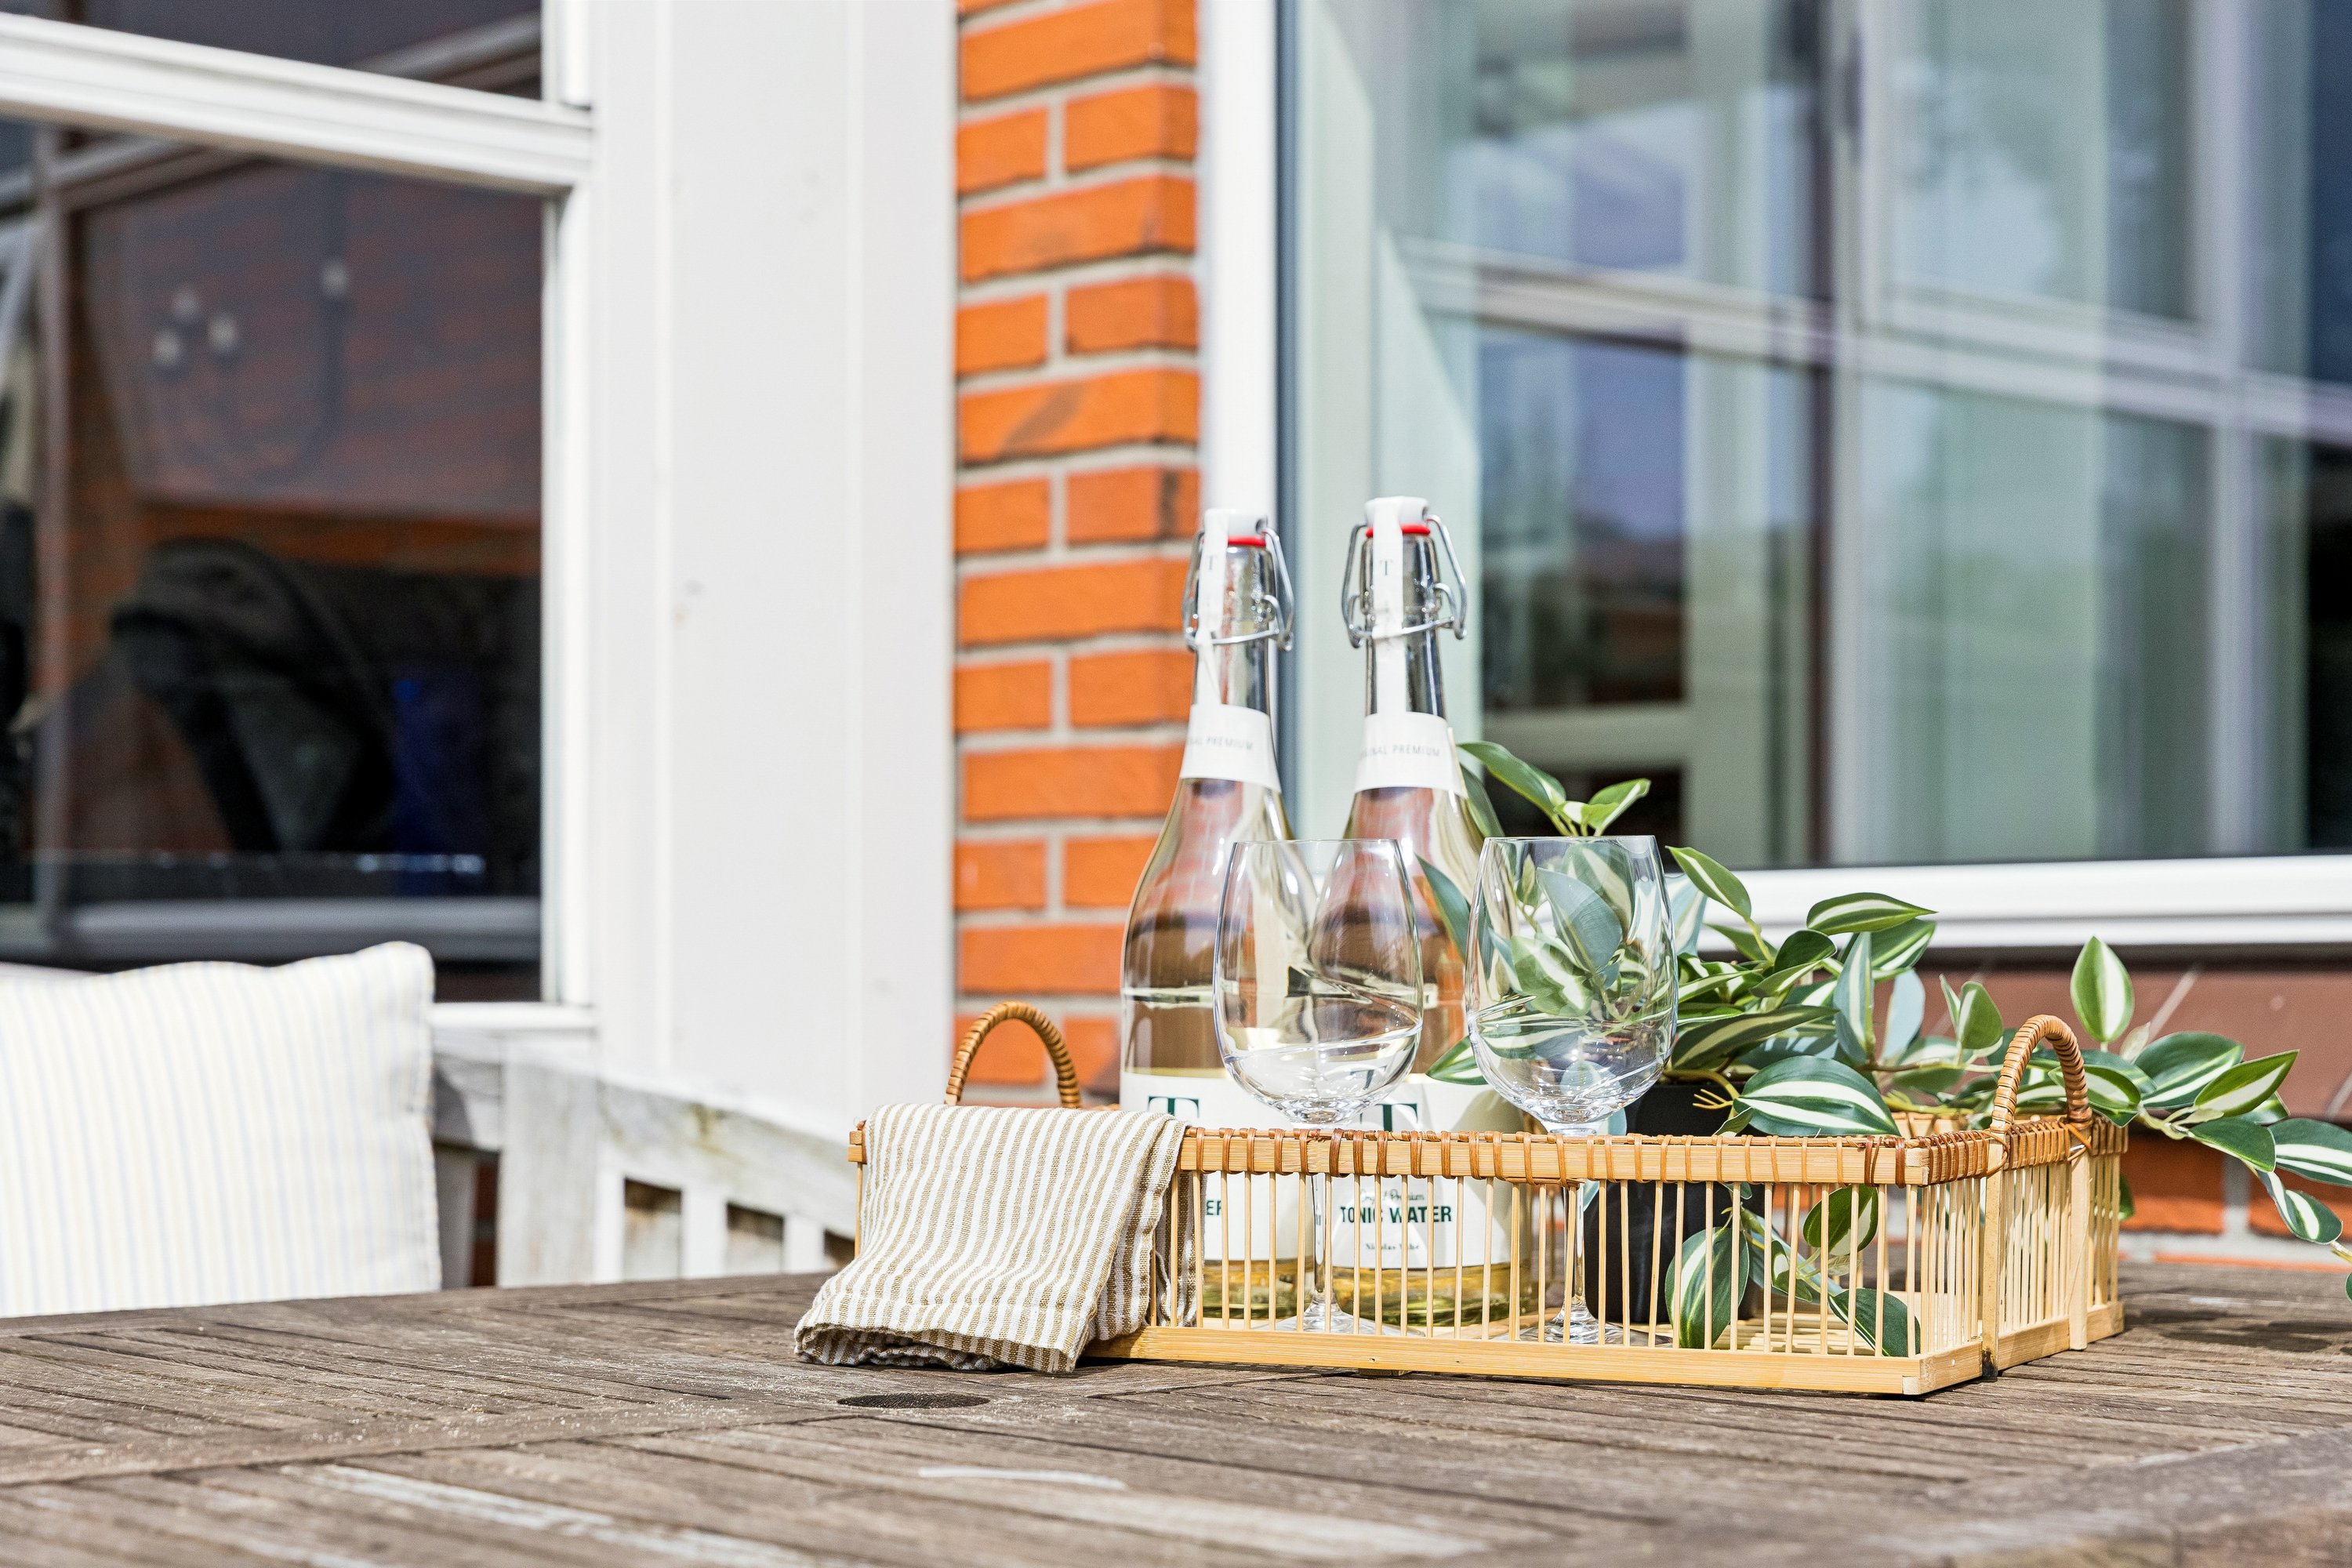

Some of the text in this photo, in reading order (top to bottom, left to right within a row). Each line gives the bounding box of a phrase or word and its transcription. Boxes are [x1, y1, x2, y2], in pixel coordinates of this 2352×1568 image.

[1379, 559, 1393, 576] T
[1392, 743, 1440, 757] PREMIUM
[1389, 1205, 1452, 1223] WATER
